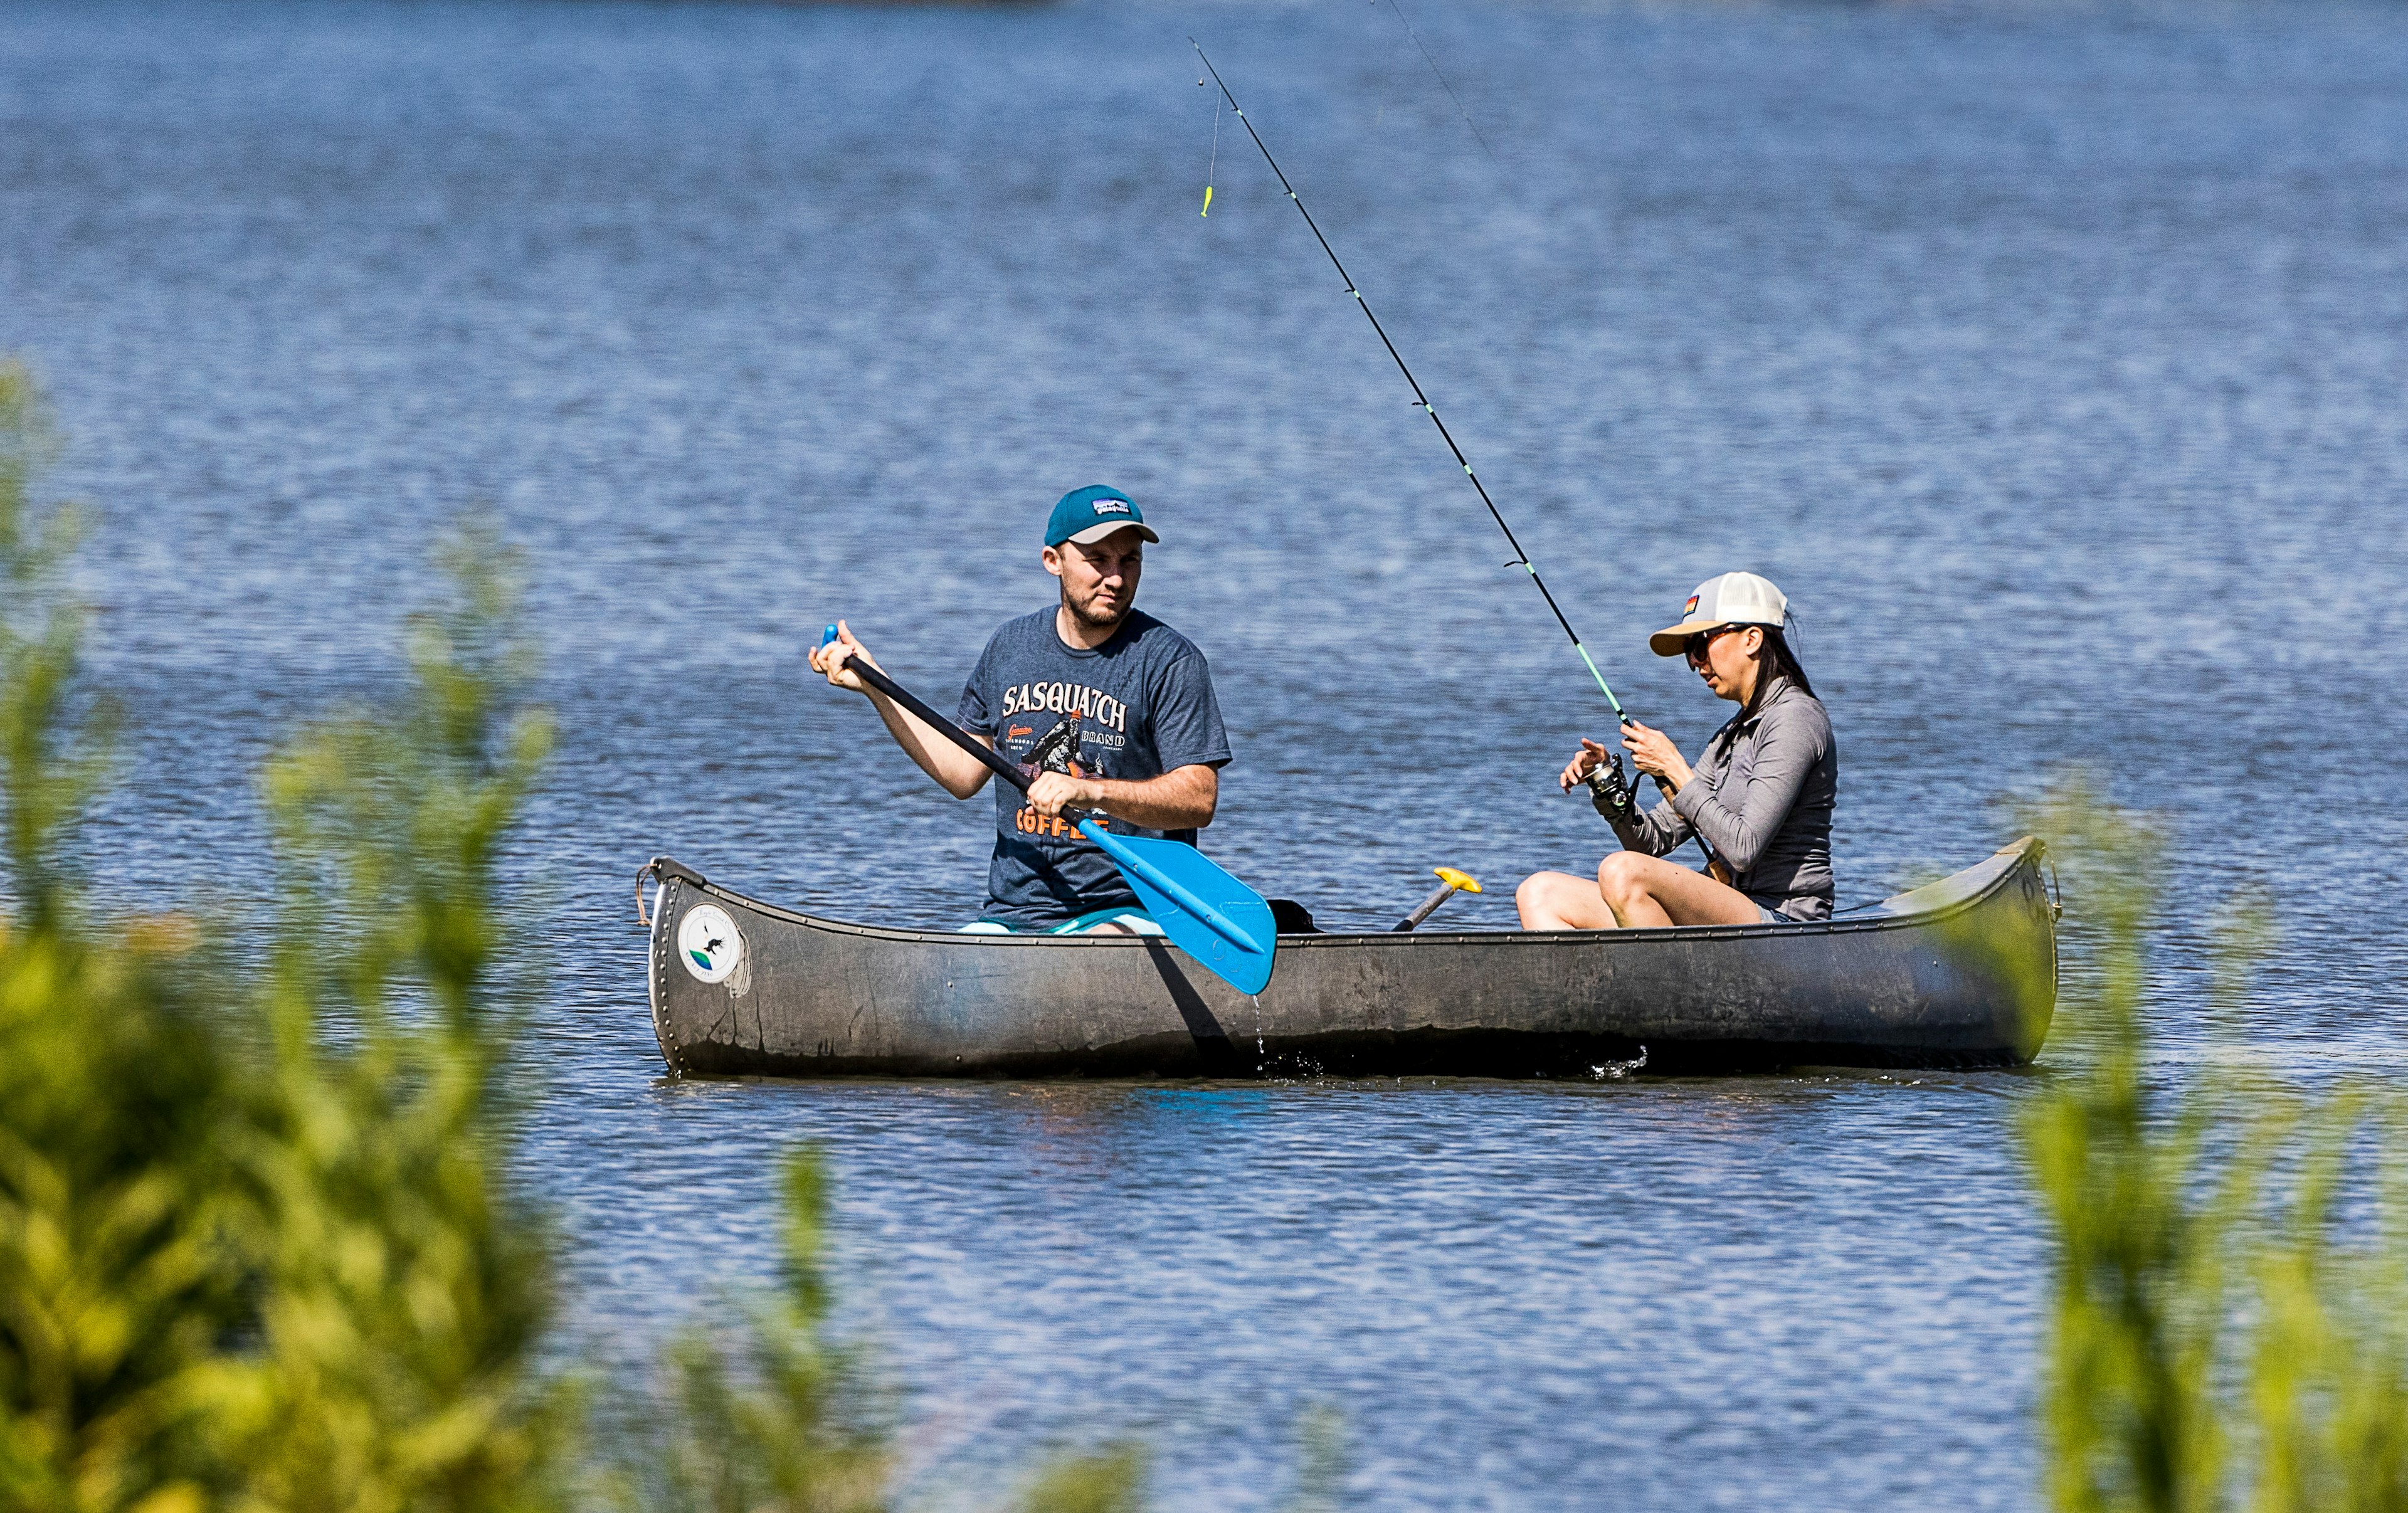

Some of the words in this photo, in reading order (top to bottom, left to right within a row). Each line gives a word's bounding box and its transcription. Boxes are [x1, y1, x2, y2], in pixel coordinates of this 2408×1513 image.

[1097, 505, 1129, 515] patagonia
[1003, 682, 1127, 732] SASQUATCH
[1008, 724, 1033, 739] Genuine
[1081, 730, 1125, 746] BRAND
